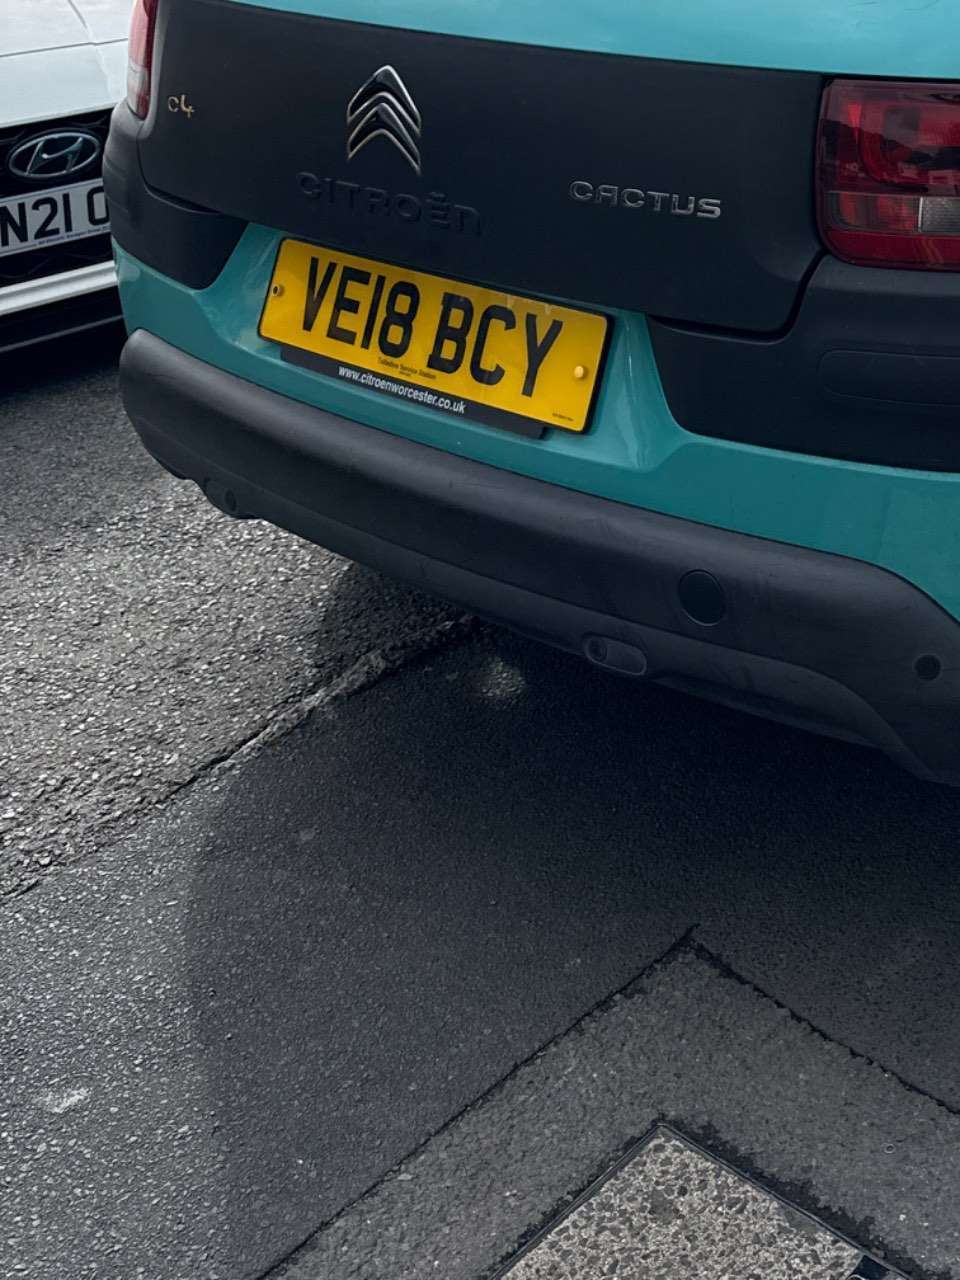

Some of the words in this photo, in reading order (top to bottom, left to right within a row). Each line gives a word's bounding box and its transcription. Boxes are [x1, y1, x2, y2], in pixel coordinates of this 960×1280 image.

[167, 94, 195, 118] C4
[0, 192, 73, 247] N21
[568, 180, 722, 219] CACTUS
[301, 256, 420, 359] VE18
[427, 291, 564, 398] BCY
[338, 366, 467, 414] www.citroenworcester.co.uk
